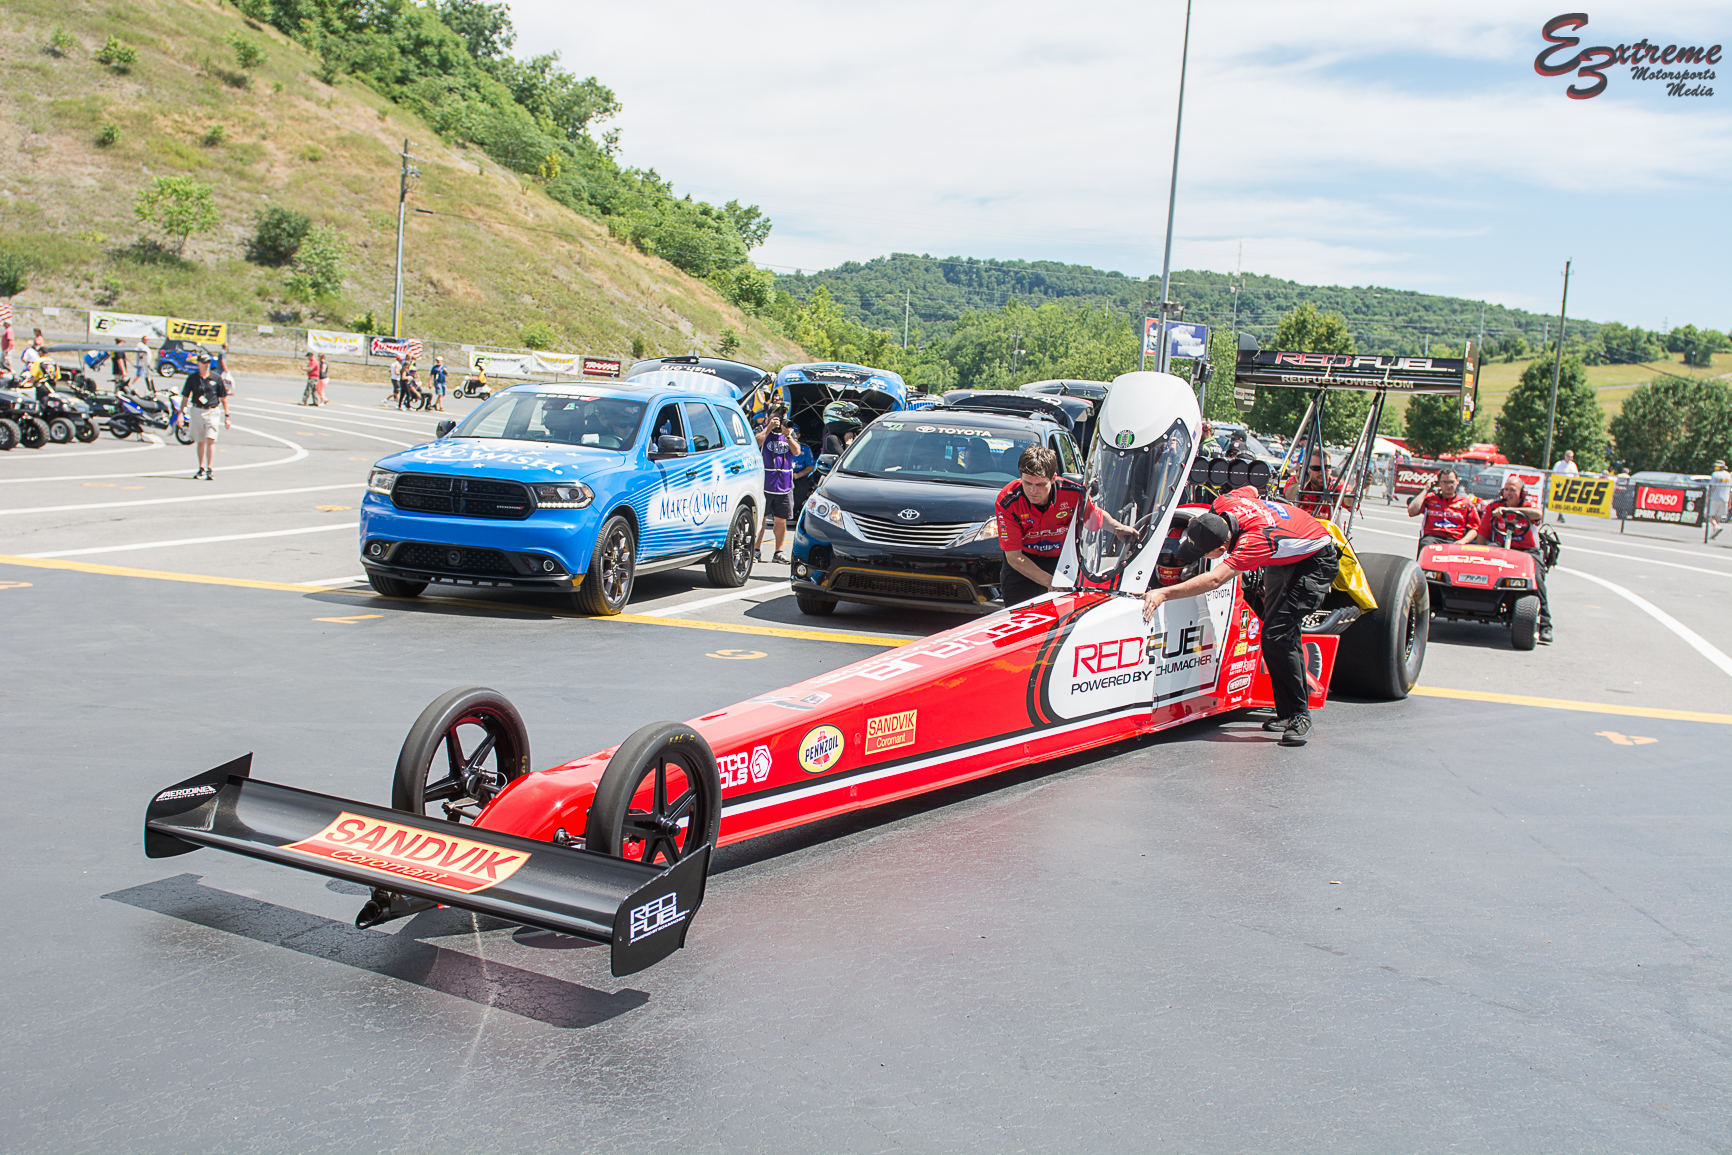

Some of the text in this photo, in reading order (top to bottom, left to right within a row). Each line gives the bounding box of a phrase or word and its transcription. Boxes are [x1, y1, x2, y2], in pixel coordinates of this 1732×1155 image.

[172, 322, 222, 337] JEGS
[585, 361, 619, 371] TRAXXAS
[1281, 374, 1415, 389] REDFUELPOWER.COM
[938, 427, 992, 437] TOYOTA
[1397, 470, 1439, 484] TRAXXA
[1553, 478, 1610, 506] JEGS
[1647, 493, 1678, 506] DENSO
[1634, 508, 1656, 519] SPARK
[1656, 510, 1681, 522] PLUGS
[1212, 588, 1231, 600] TOYOTA
[1070, 673, 1131, 695] POWERED
[1132, 670, 1153, 682] BY
[1155, 654, 1212, 677] CHUMACHER
[868, 711, 915, 737] SANDVIK
[804, 734, 839, 762] PENNZOIL
[876, 732, 906, 748] Coromant
[716, 751, 748, 773] TCO
[163, 785, 210, 799] AERODINE
[324, 818, 520, 880] SANDVIK
[330, 850, 450, 882] Coromant
[630, 891, 677, 925] RED
[630, 905, 686, 939] FUEL
